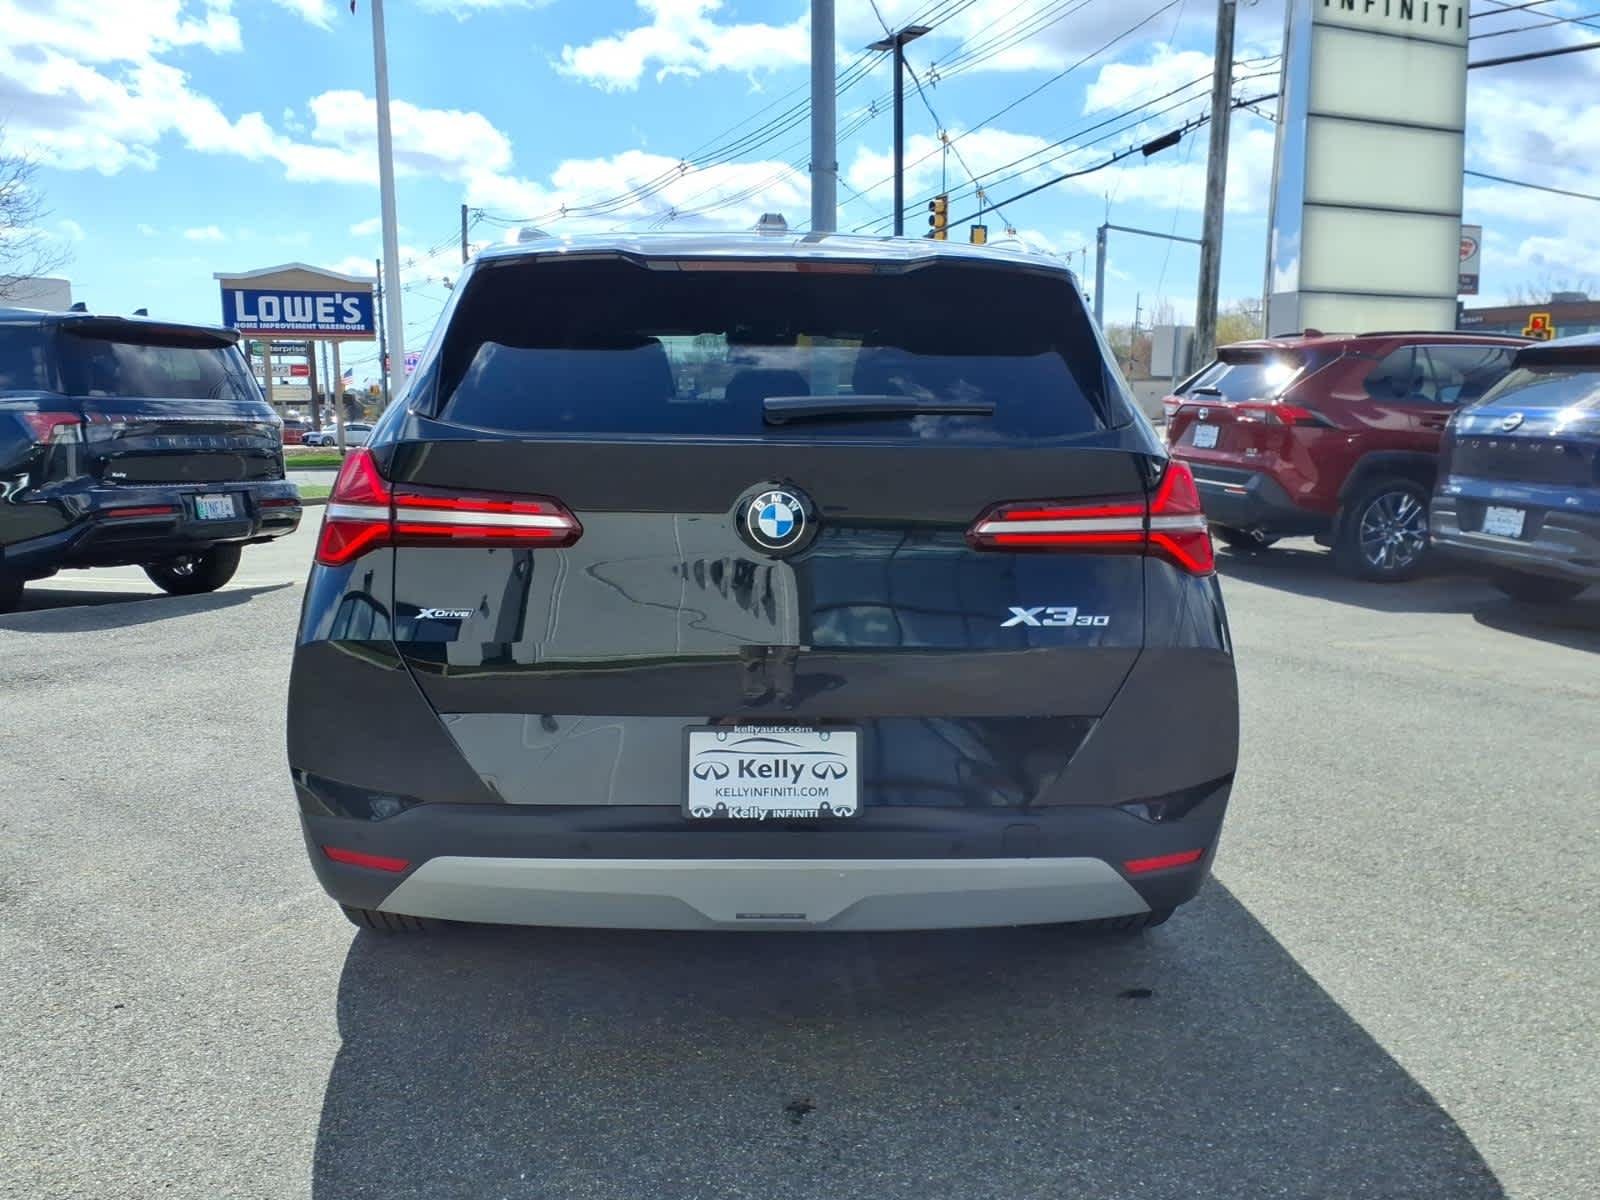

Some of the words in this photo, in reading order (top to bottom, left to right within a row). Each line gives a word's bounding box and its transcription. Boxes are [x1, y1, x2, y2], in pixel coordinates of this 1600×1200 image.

[235, 291, 362, 323] LOWE'S
[318, 323, 365, 331] WAREHOUSE
[753, 494, 800, 511] BMW
[734, 725, 813, 735] kellyauto.com
[738, 759, 806, 784] Kelly
[715, 787, 829, 797] KELLYINFINITI.COM
[728, 806, 769, 821] Kelly
[773, 808, 819, 818] INFINITI
